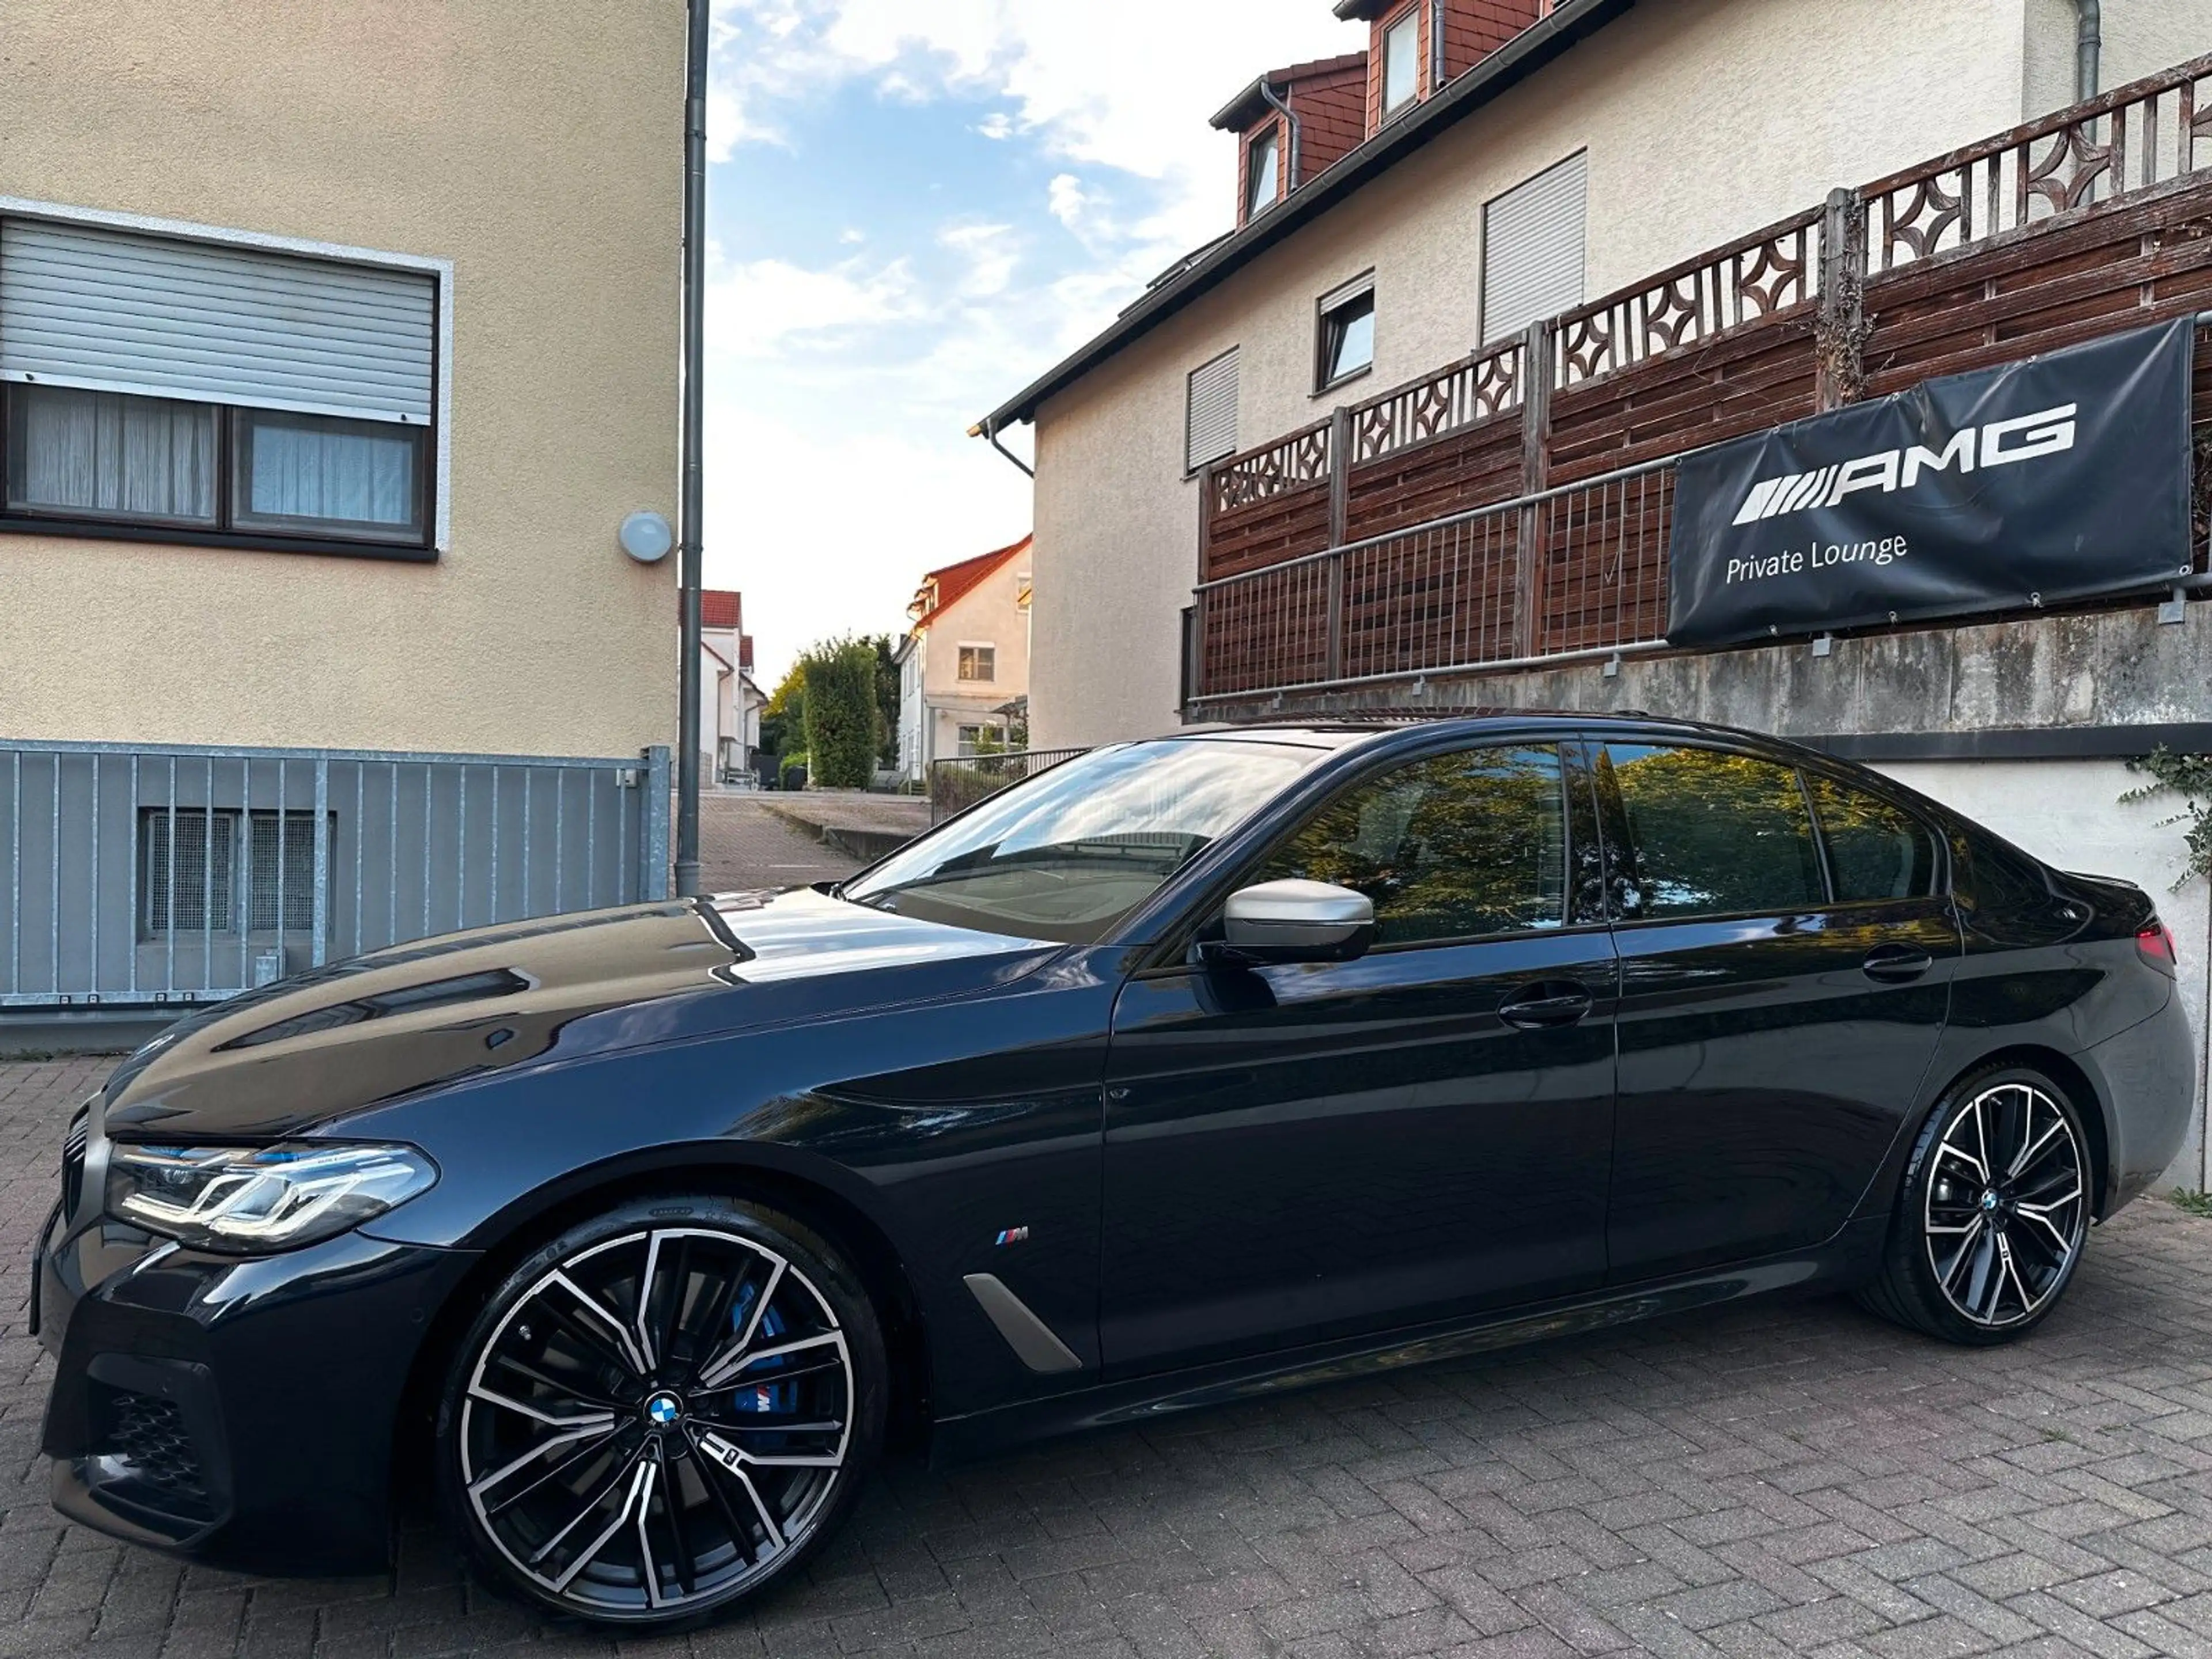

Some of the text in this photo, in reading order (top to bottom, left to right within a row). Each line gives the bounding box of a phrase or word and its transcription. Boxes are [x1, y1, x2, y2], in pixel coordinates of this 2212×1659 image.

[1825, 403, 2077, 507] AMG
[1726, 535, 1907, 584] Private Lounge
